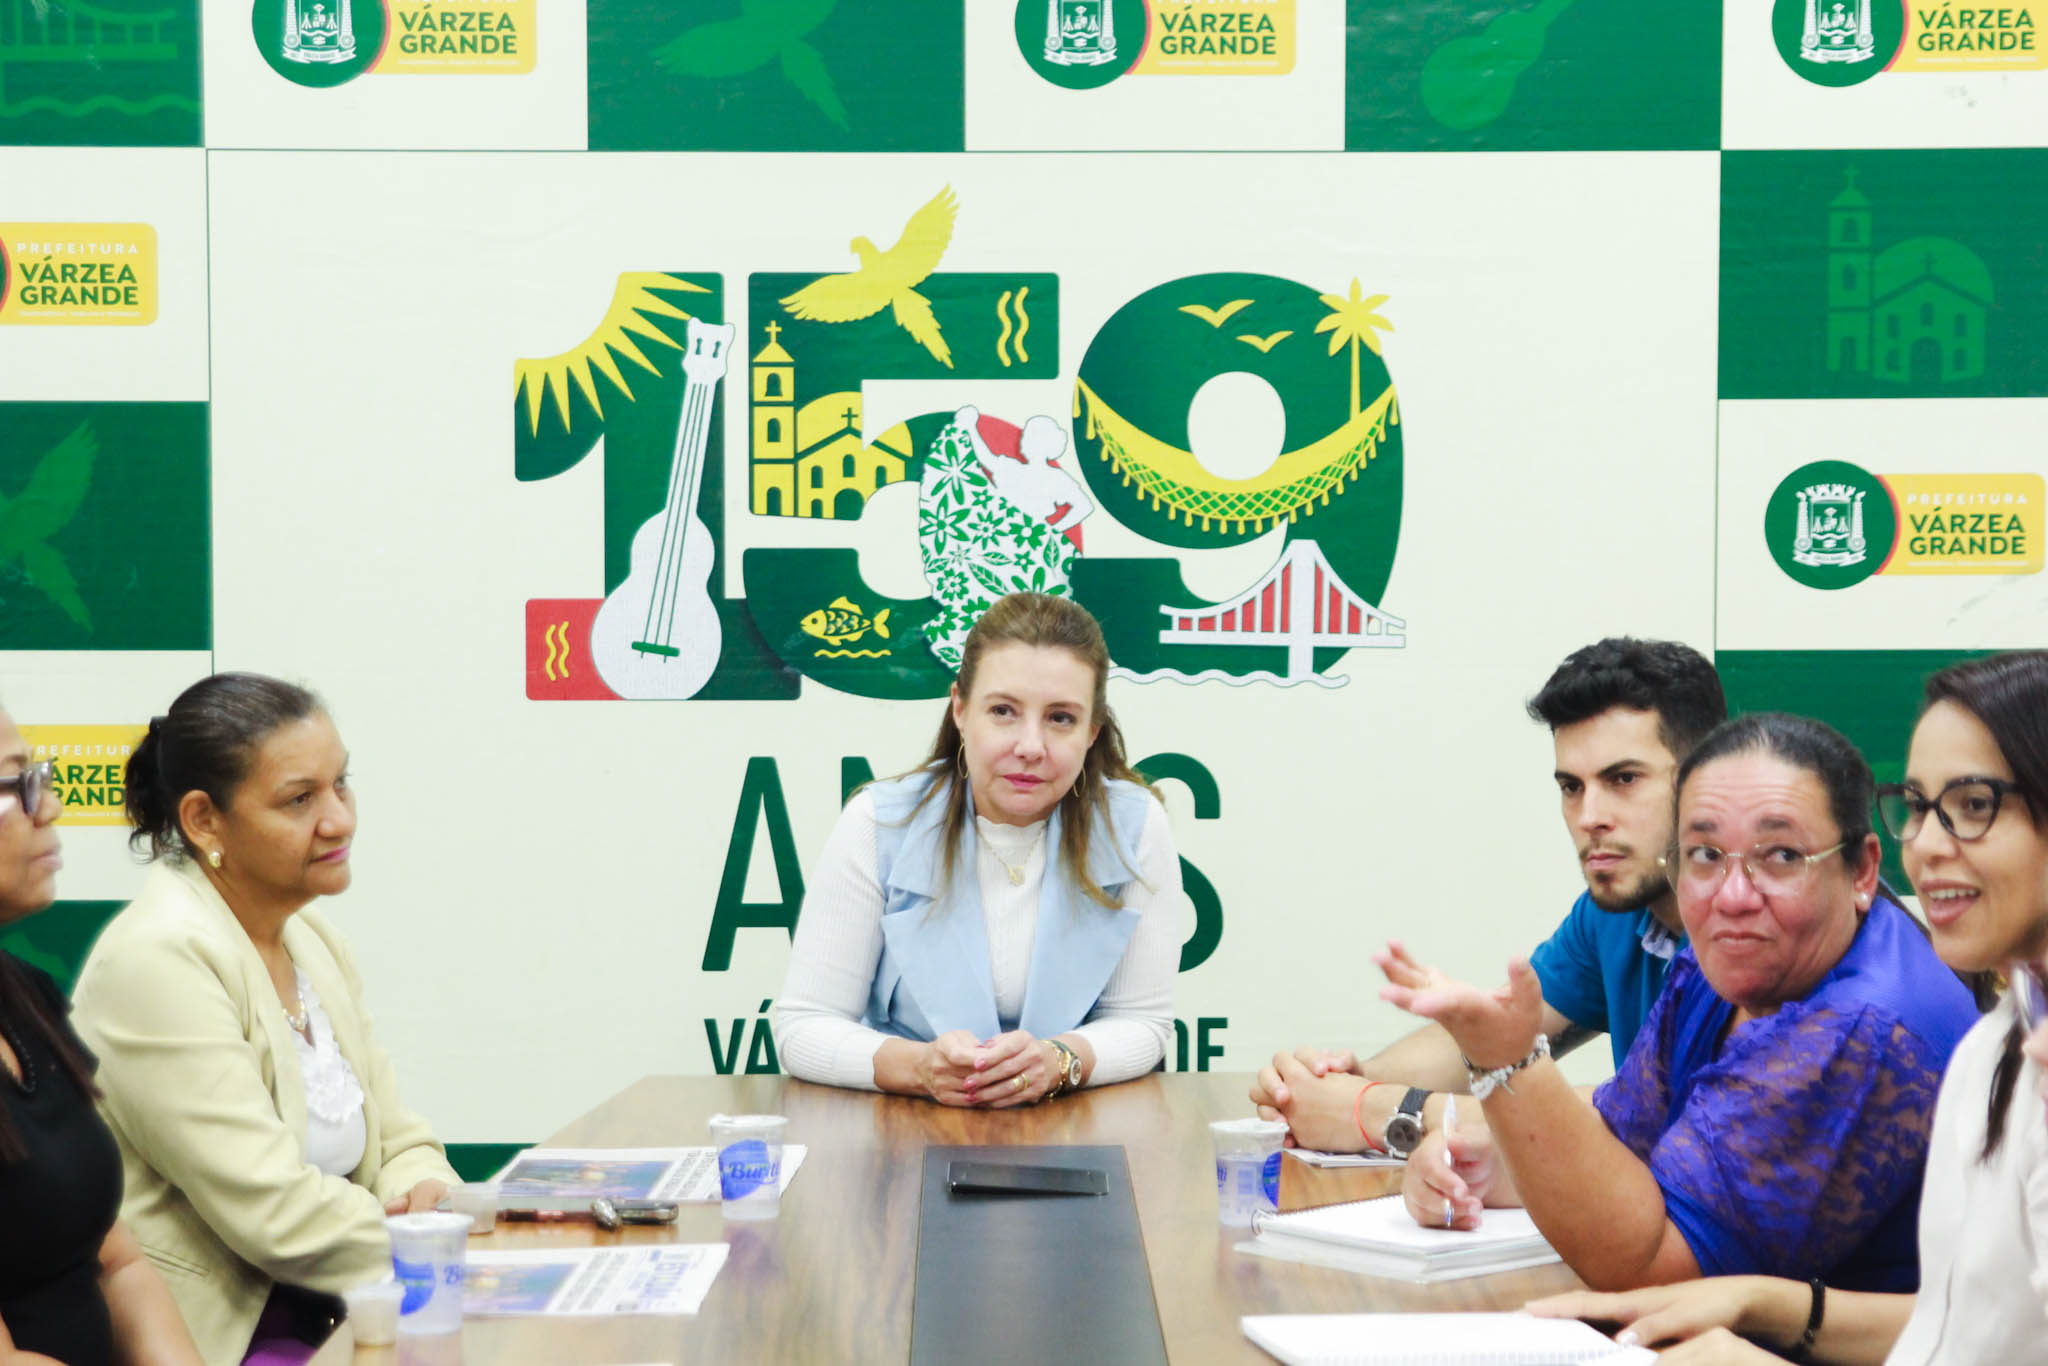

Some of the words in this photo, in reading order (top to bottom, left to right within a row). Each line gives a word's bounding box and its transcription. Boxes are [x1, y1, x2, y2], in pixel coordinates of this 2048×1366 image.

[399, 4, 516, 32] VÁRZEA
[1160, 5, 1275, 33] VÁRZEA
[1918, 2, 2035, 29] VÁRZEA
[399, 34, 517, 54] GRANDE
[1160, 35, 1277, 55] GRANDE
[1918, 32, 2036, 51] GRANDE
[16, 242, 139, 255] PREFEITURA
[19, 255, 137, 284] VÁRZEA
[19, 285, 139, 305] GRANDE
[513, 272, 1404, 701] 159
[1907, 493, 2028, 505] PREFEITURA
[1909, 506, 2025, 534] VÁRZEA
[1909, 536, 2026, 555] GRANDE
